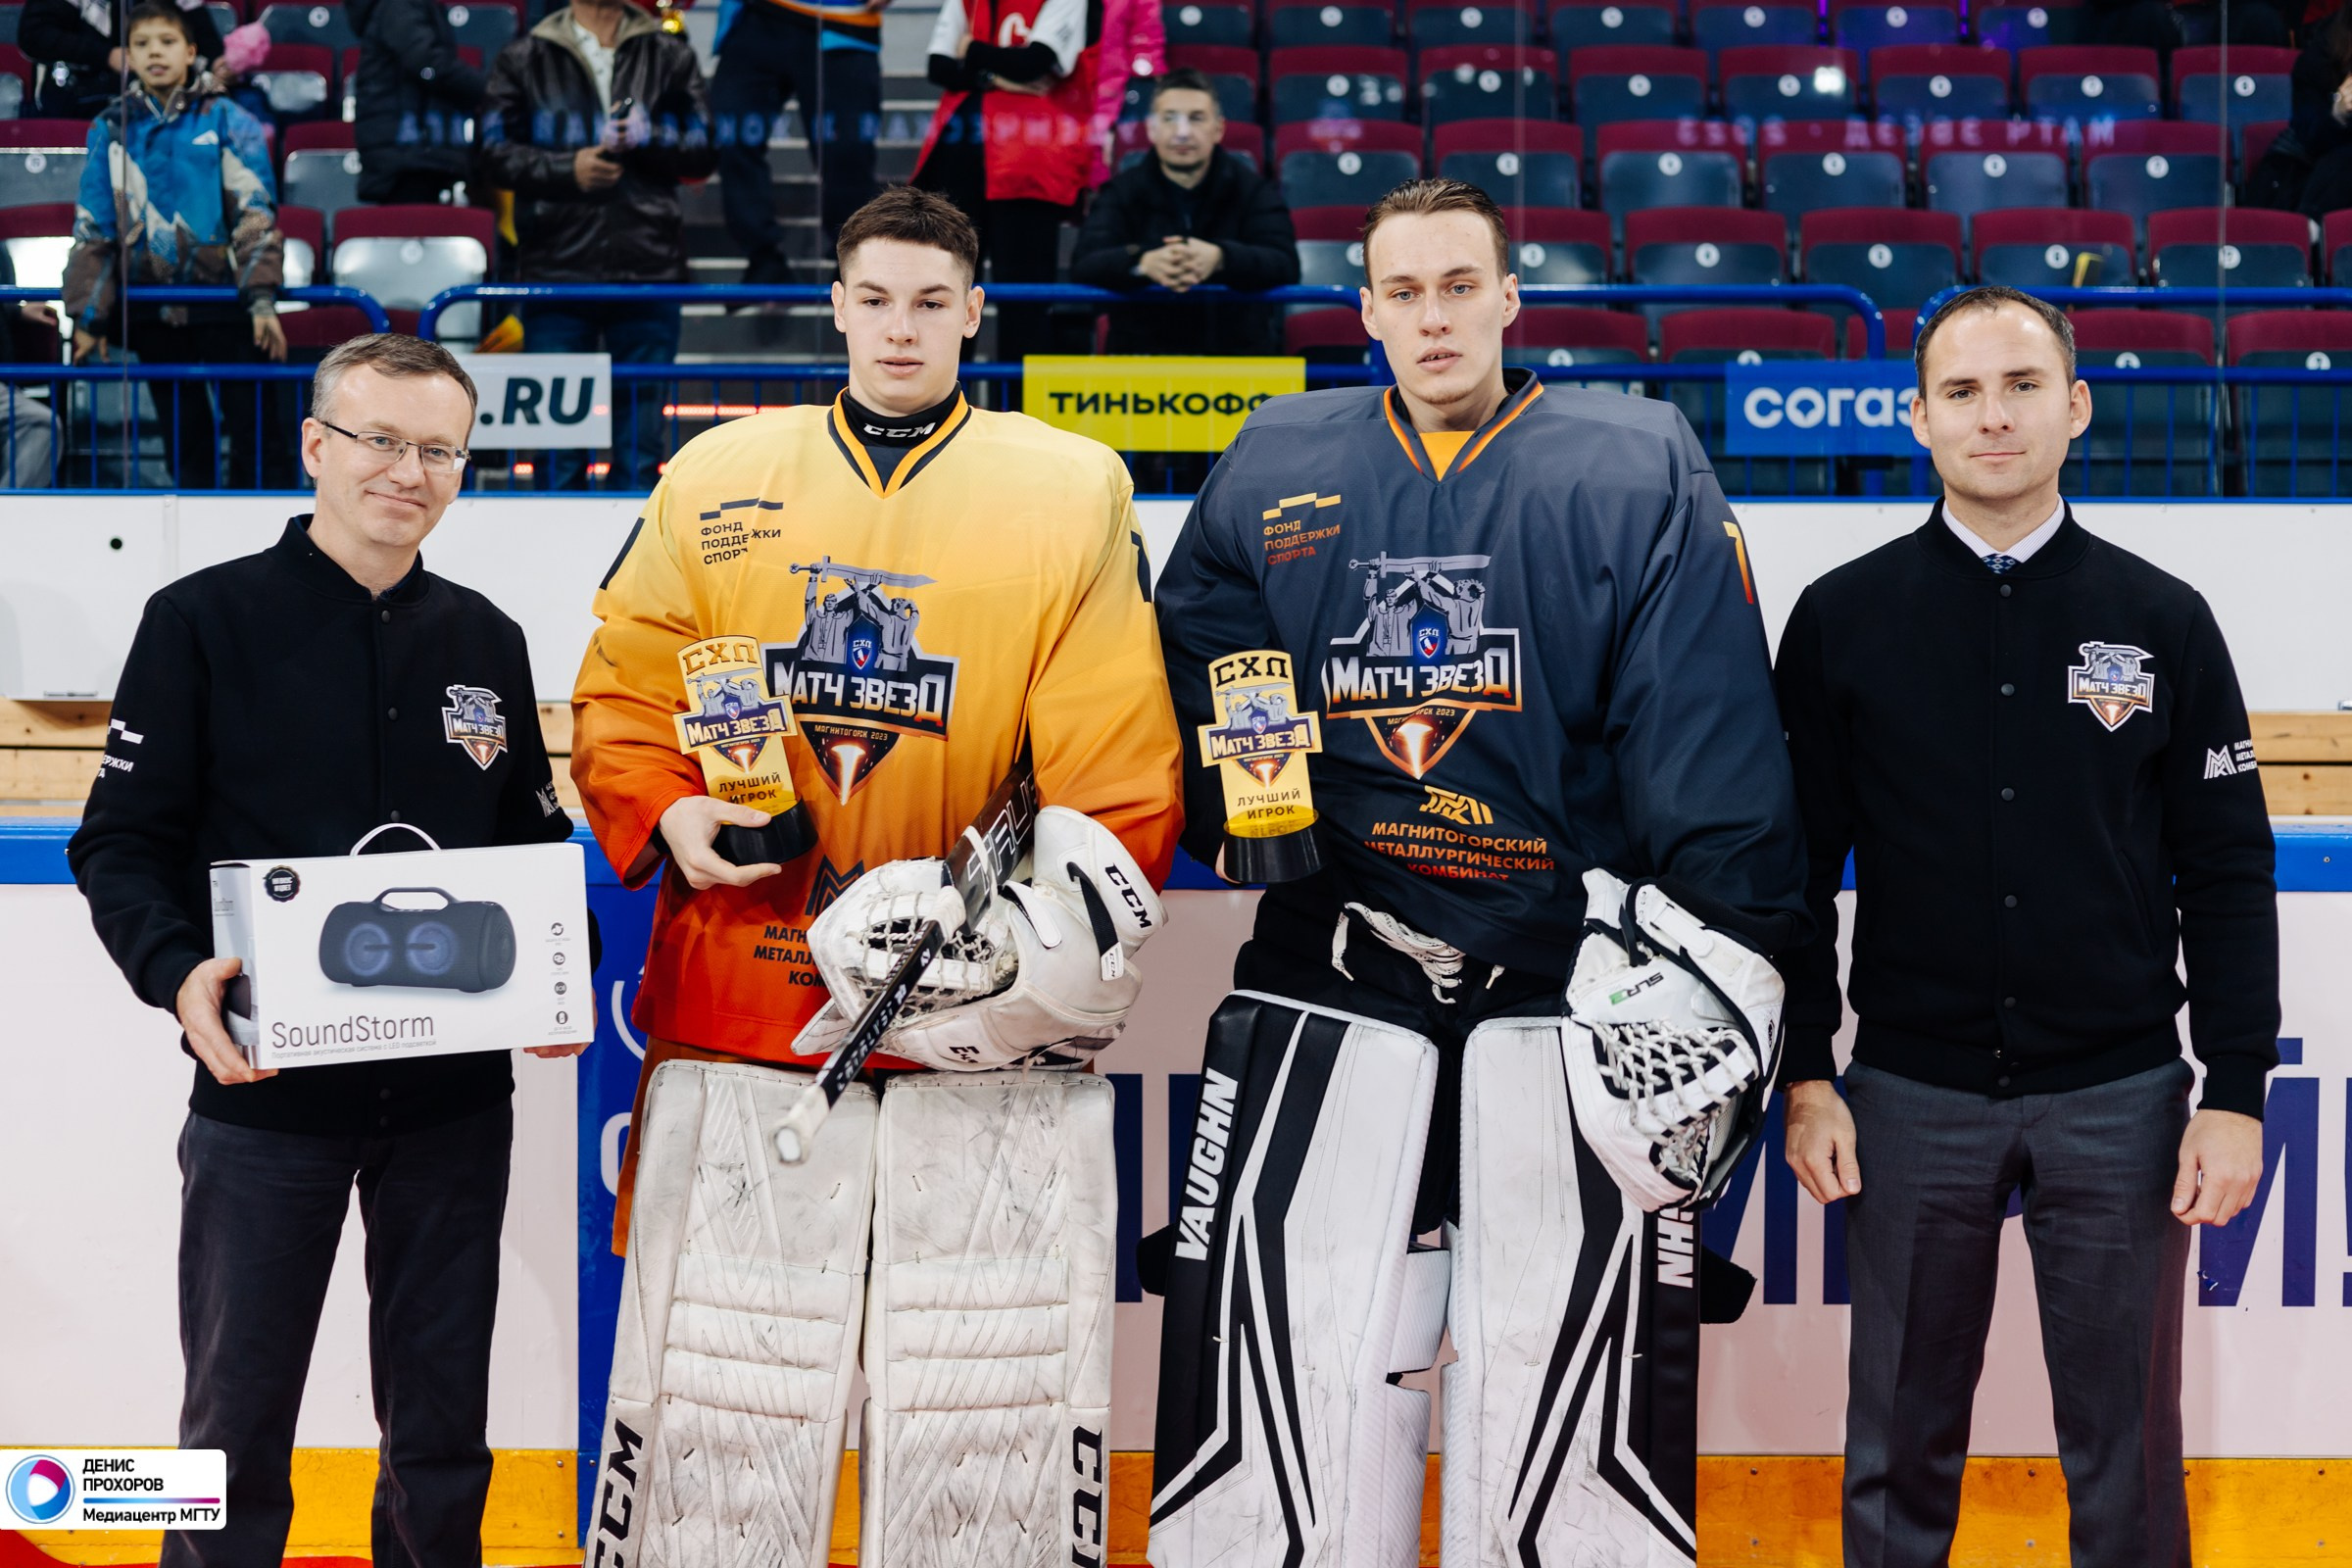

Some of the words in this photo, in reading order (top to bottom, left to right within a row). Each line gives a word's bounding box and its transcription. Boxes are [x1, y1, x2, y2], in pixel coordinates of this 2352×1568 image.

[863, 421, 937, 438] CCM
[700, 521, 744, 536] ФОНД
[1263, 519, 1301, 536] ФОНД
[1263, 523, 1342, 552] ПОДДЕРЖКИ
[1266, 545, 1317, 565] СПОРТА
[682, 642, 759, 676] СХП
[1214, 655, 1290, 688] СХП
[1435, 707, 1456, 717] 2023
[870, 730, 889, 742] 2023
[718, 771, 781, 793] ЛУЧШИЙ
[1237, 787, 1301, 808] ЛУЧШИЙ
[1248, 805, 1297, 820] ИГРОК
[1371, 821, 1548, 856] МАГНИТОГОРСКИЙ
[1104, 861, 1153, 930] CCM
[271, 1014, 434, 1049] SoundStorm
[1175, 1066, 1239, 1261] VAUGHN
